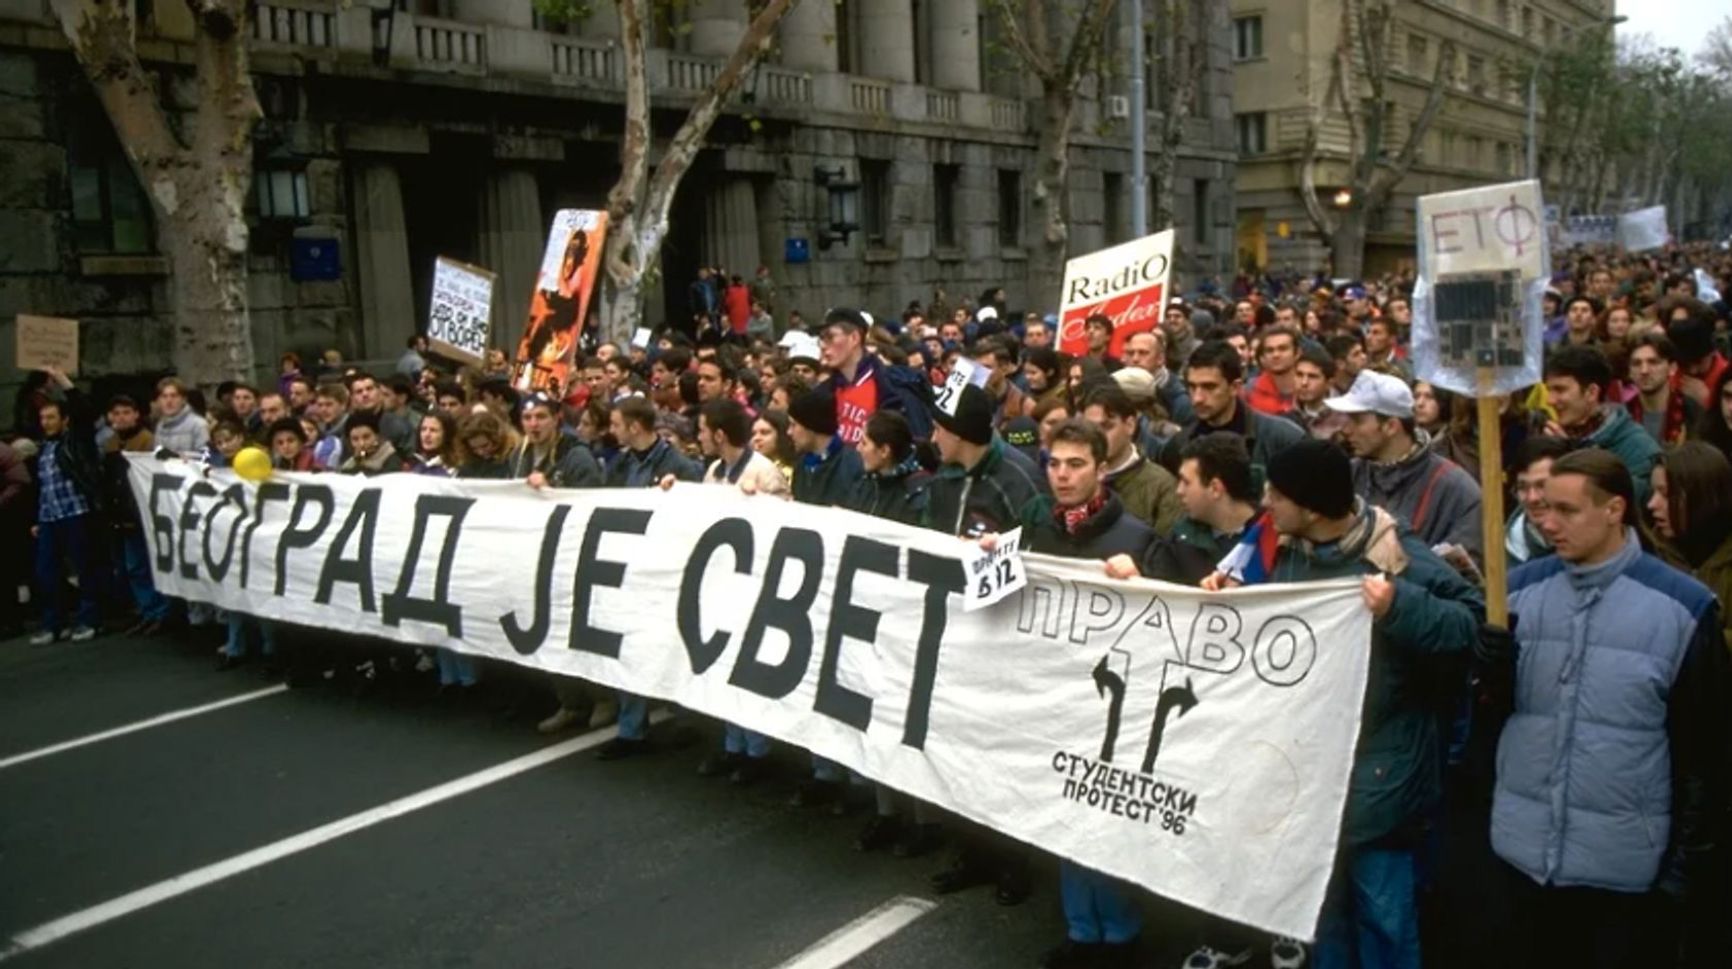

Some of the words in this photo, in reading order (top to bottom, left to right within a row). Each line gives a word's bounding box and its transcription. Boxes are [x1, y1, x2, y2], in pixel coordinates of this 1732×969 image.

[1431, 194, 1537, 258] ЕТФ
[149, 473, 478, 639] БЕОГРАД
[500, 504, 654, 659] ЈЕ
[677, 517, 967, 751] СВЕТ
[1017, 576, 1317, 687] ПРАВО
[1052, 750, 1198, 817] СТУДЕНТСКИ
[1062, 778, 1159, 824] ПРОТЕСТ
[1158, 805, 1187, 836] '96
